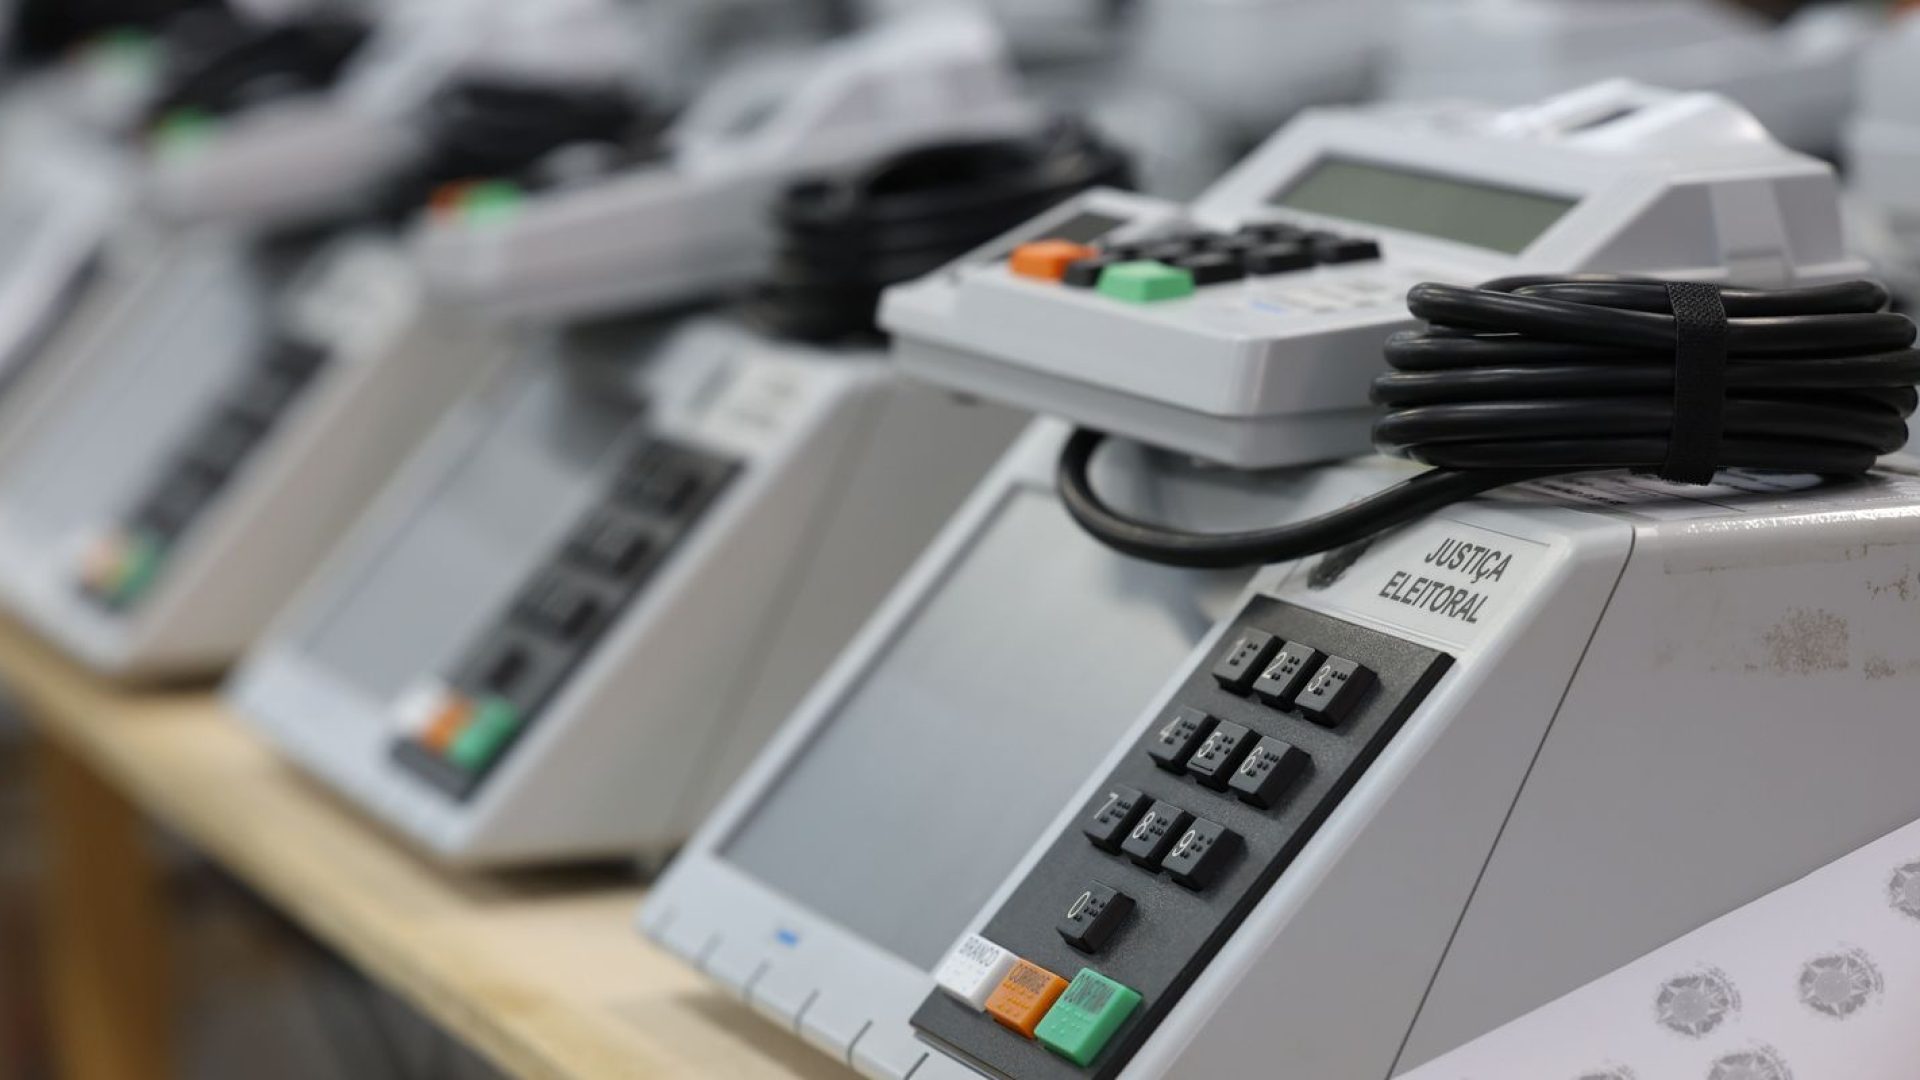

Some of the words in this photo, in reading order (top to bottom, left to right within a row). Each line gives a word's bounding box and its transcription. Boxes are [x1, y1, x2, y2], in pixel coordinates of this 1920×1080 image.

[1424, 538, 1513, 584] JUSTIÇA
[1378, 570, 1488, 624] ELEITORAL
[1225, 637, 1247, 664] 1
[1262, 651, 1288, 679] 2
[1307, 665, 1331, 692] 3
[1159, 715, 1182, 743] 4
[1197, 731, 1223, 758] 5
[1240, 746, 1264, 773] 6
[1093, 792, 1119, 819] 7
[1132, 811, 1156, 839] 8
[1171, 829, 1196, 857] 9
[1066, 891, 1092, 919] 0
